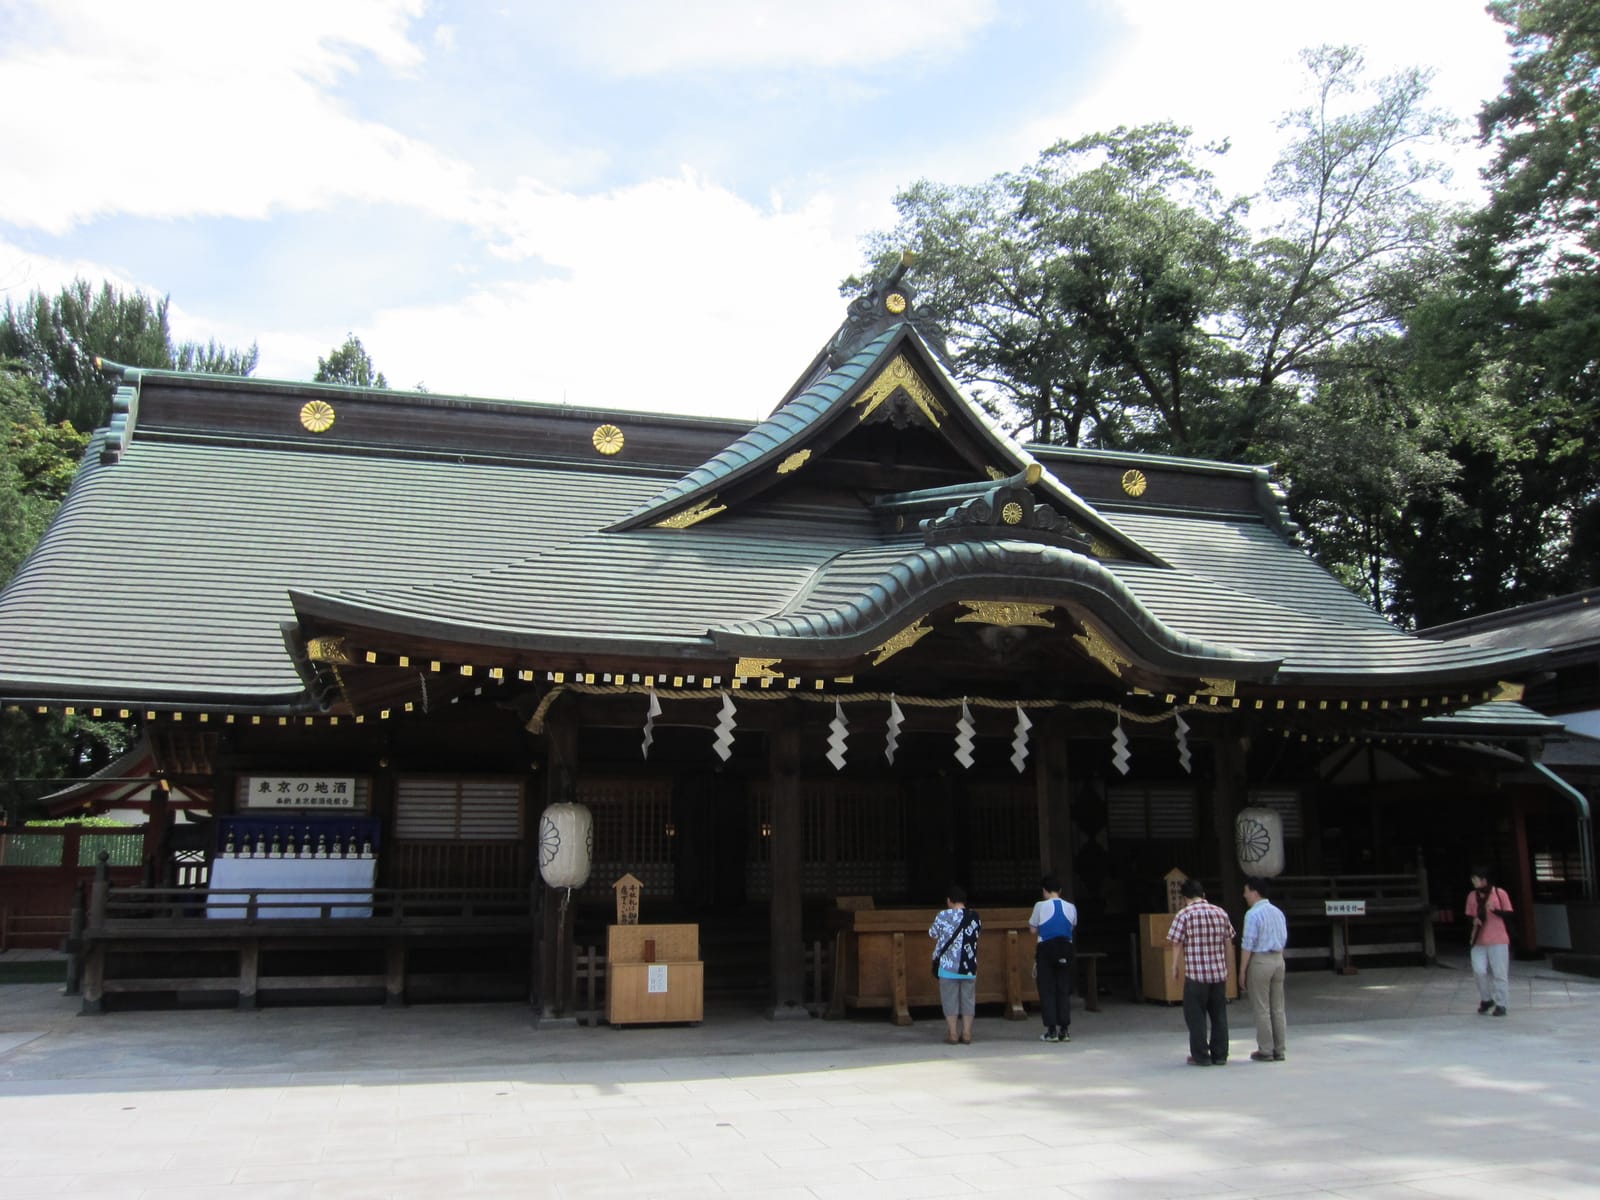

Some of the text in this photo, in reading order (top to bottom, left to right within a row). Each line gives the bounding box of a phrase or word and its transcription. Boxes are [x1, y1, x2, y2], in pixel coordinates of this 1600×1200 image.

[258, 781, 347, 794] 東京の地酒
